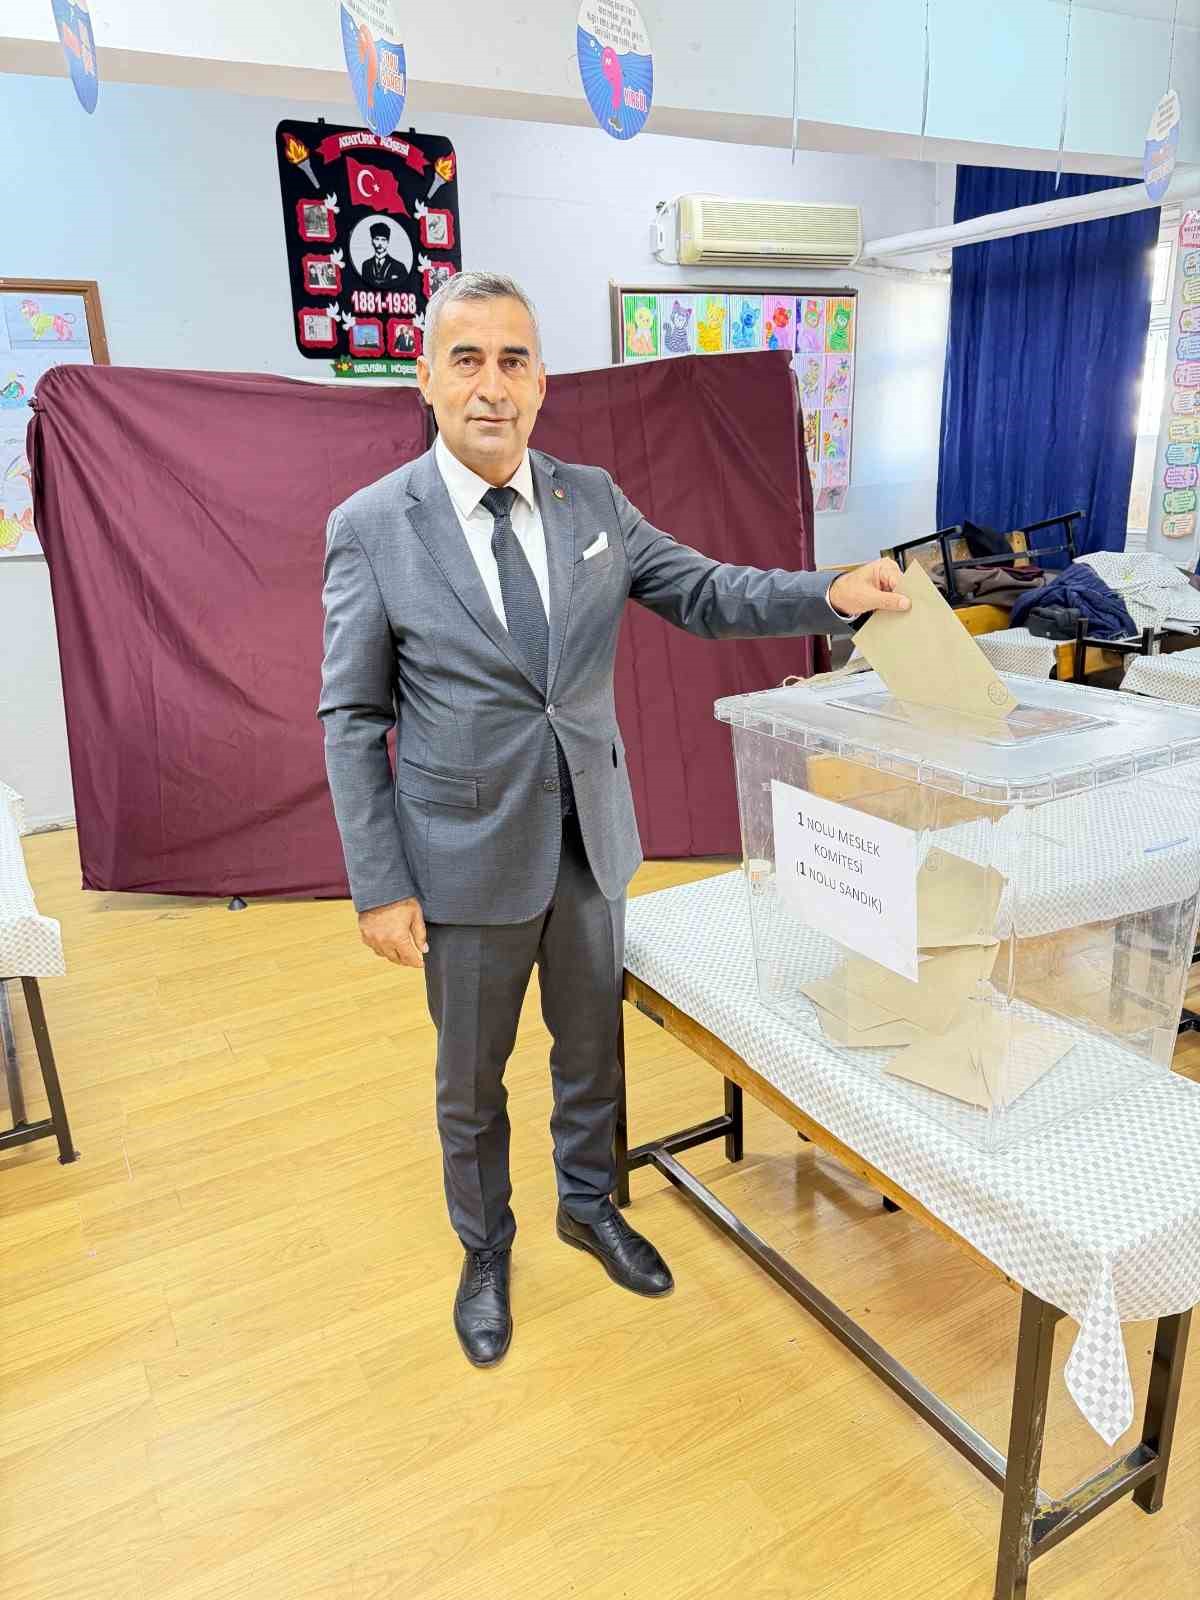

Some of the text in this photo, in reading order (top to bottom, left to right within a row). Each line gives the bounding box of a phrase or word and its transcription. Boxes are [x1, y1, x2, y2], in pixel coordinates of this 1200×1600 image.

[339, 132, 376, 149] ATATÜRK
[351, 290, 416, 314] 1881-1938
[354, 363, 387, 374] MEVSİM
[797, 811, 881, 858] 1 NOLU MESLEK
[814, 843, 864, 875] KOMİTESİ
[808, 867, 837, 891] NOLU
[839, 881, 883, 914] SANDIK)
